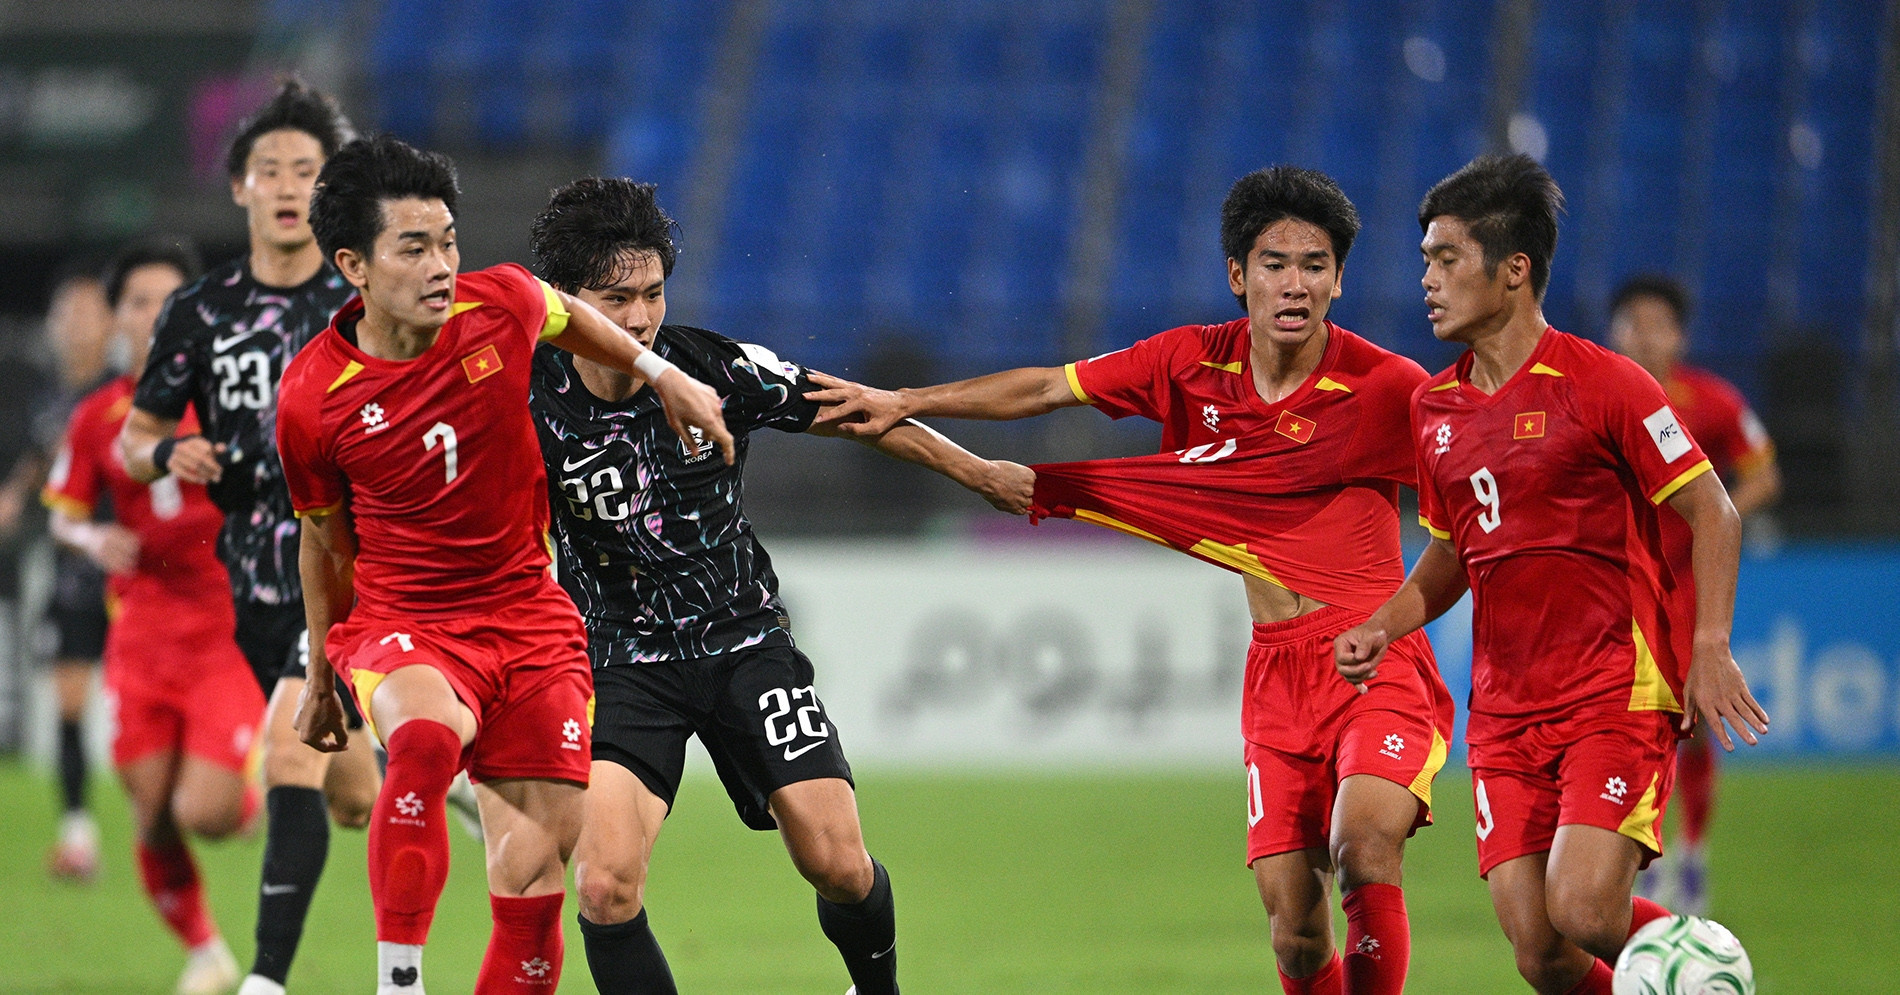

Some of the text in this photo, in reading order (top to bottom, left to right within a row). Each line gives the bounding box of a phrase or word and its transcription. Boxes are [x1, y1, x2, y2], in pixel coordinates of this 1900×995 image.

[212, 351, 271, 411] 23
[422, 421, 458, 485] 7
[685, 450, 713, 466] KOREA
[1659, 423, 1678, 444] AFC
[557, 466, 630, 522] 22
[1469, 466, 1502, 535] 9
[758, 685, 829, 746] 22
